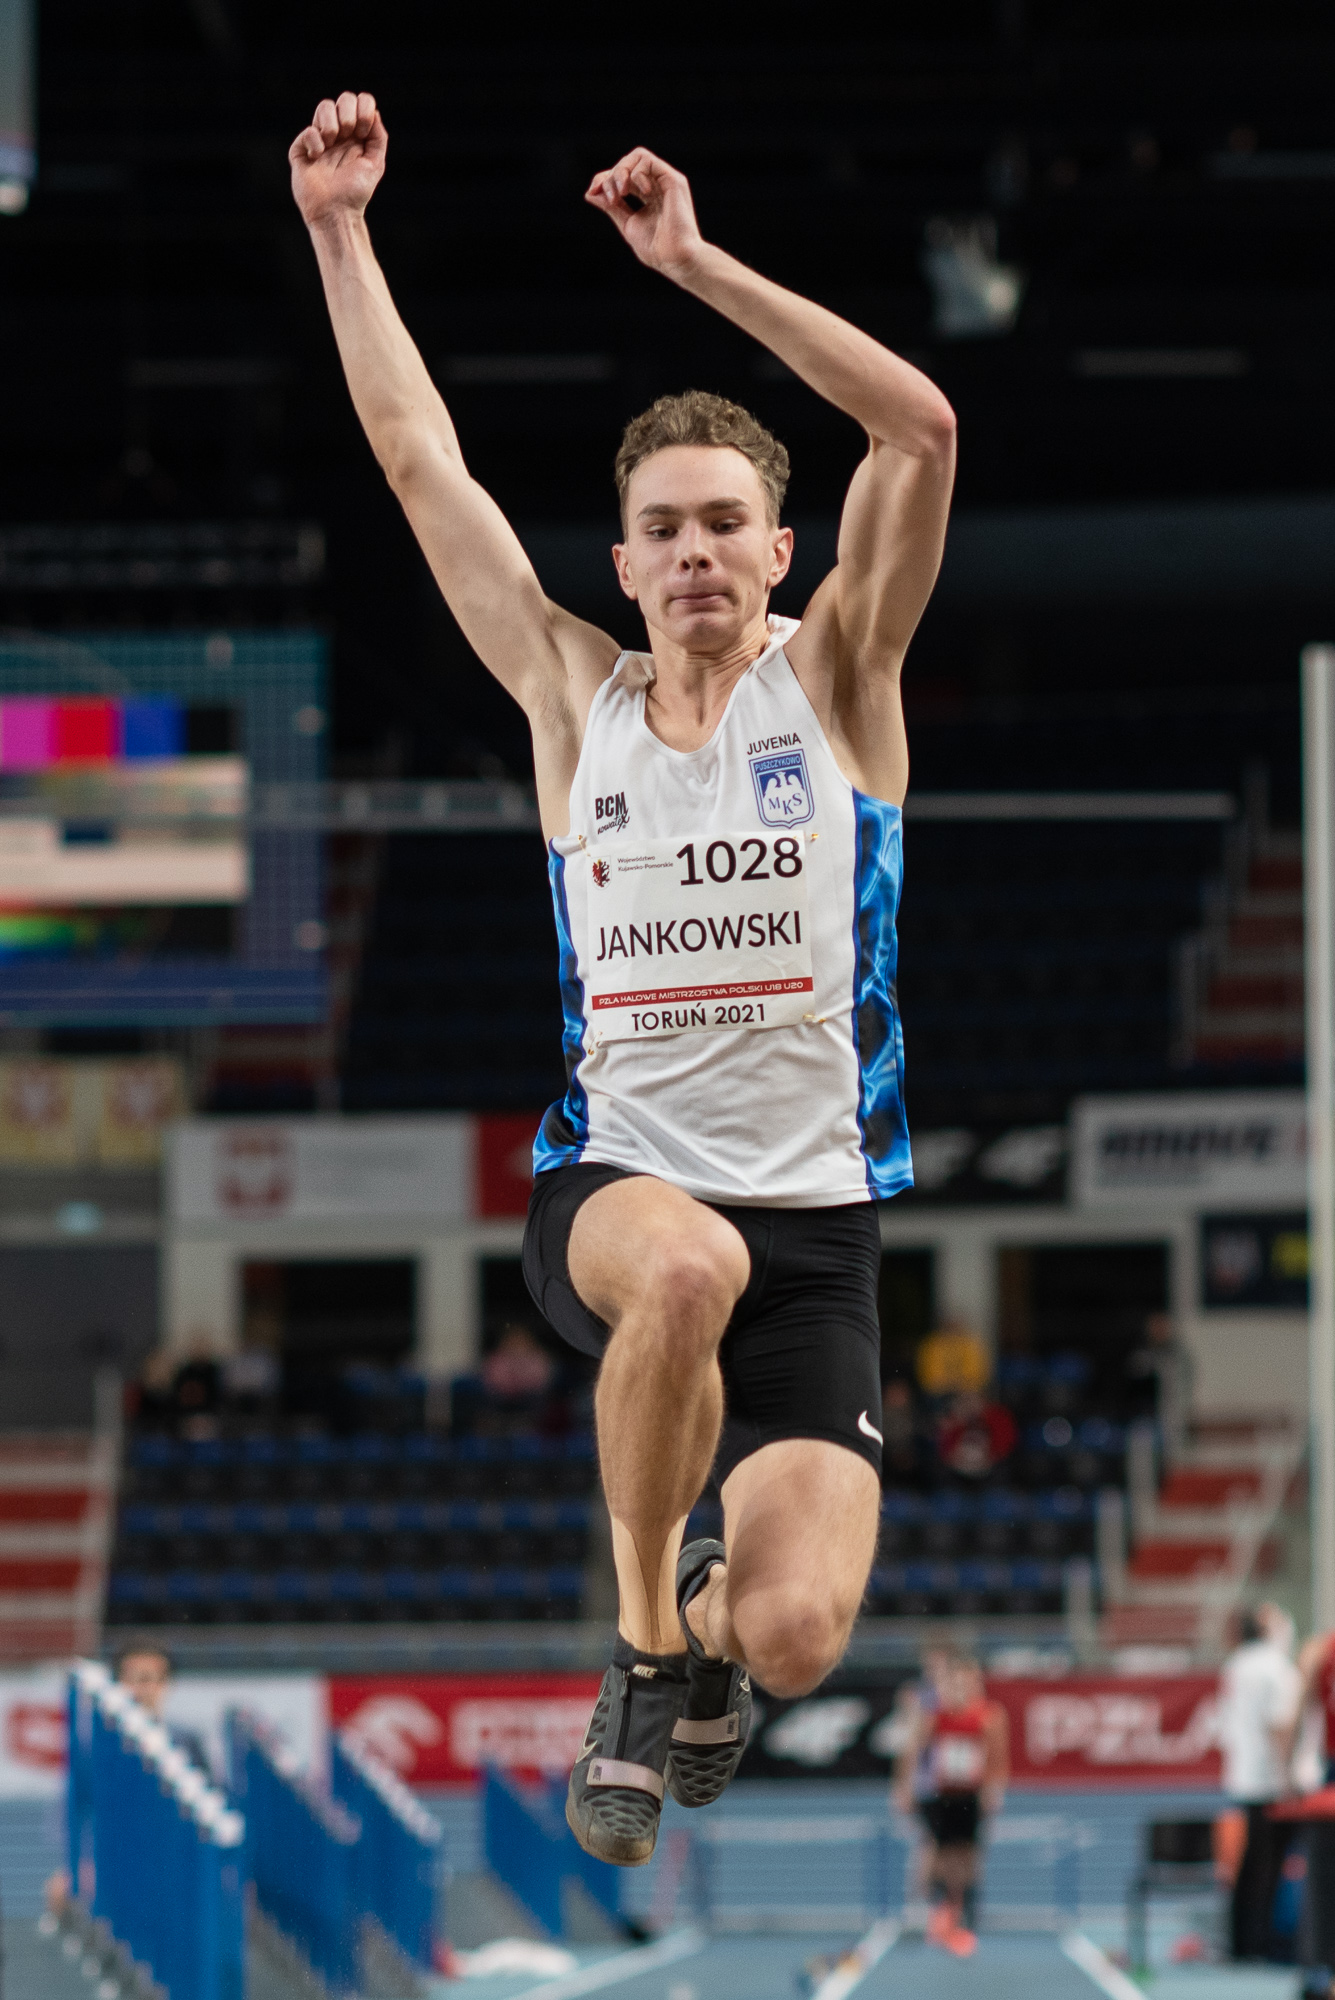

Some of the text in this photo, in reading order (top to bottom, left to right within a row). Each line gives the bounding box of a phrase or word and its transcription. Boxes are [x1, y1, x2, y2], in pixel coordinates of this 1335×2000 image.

[747, 732, 802, 755] JUVENIA
[755, 755, 801, 771] PUSZCZYKOWO
[595, 791, 627, 820] BCM
[768, 793, 803, 815] MKS
[617, 855, 656, 864] Województwo
[618, 862, 674, 872] Kujawsko-Pomorskie
[676, 837, 803, 886] 1028
[596, 910, 802, 961] JANKOWSKI
[599, 981, 804, 1006] PZLA HALOWE MISTRZOSTWA POLSKI U18 U20
[631, 1002, 766, 1032] TORUŃ 2021
[632, 1663, 658, 1679] NIKE
